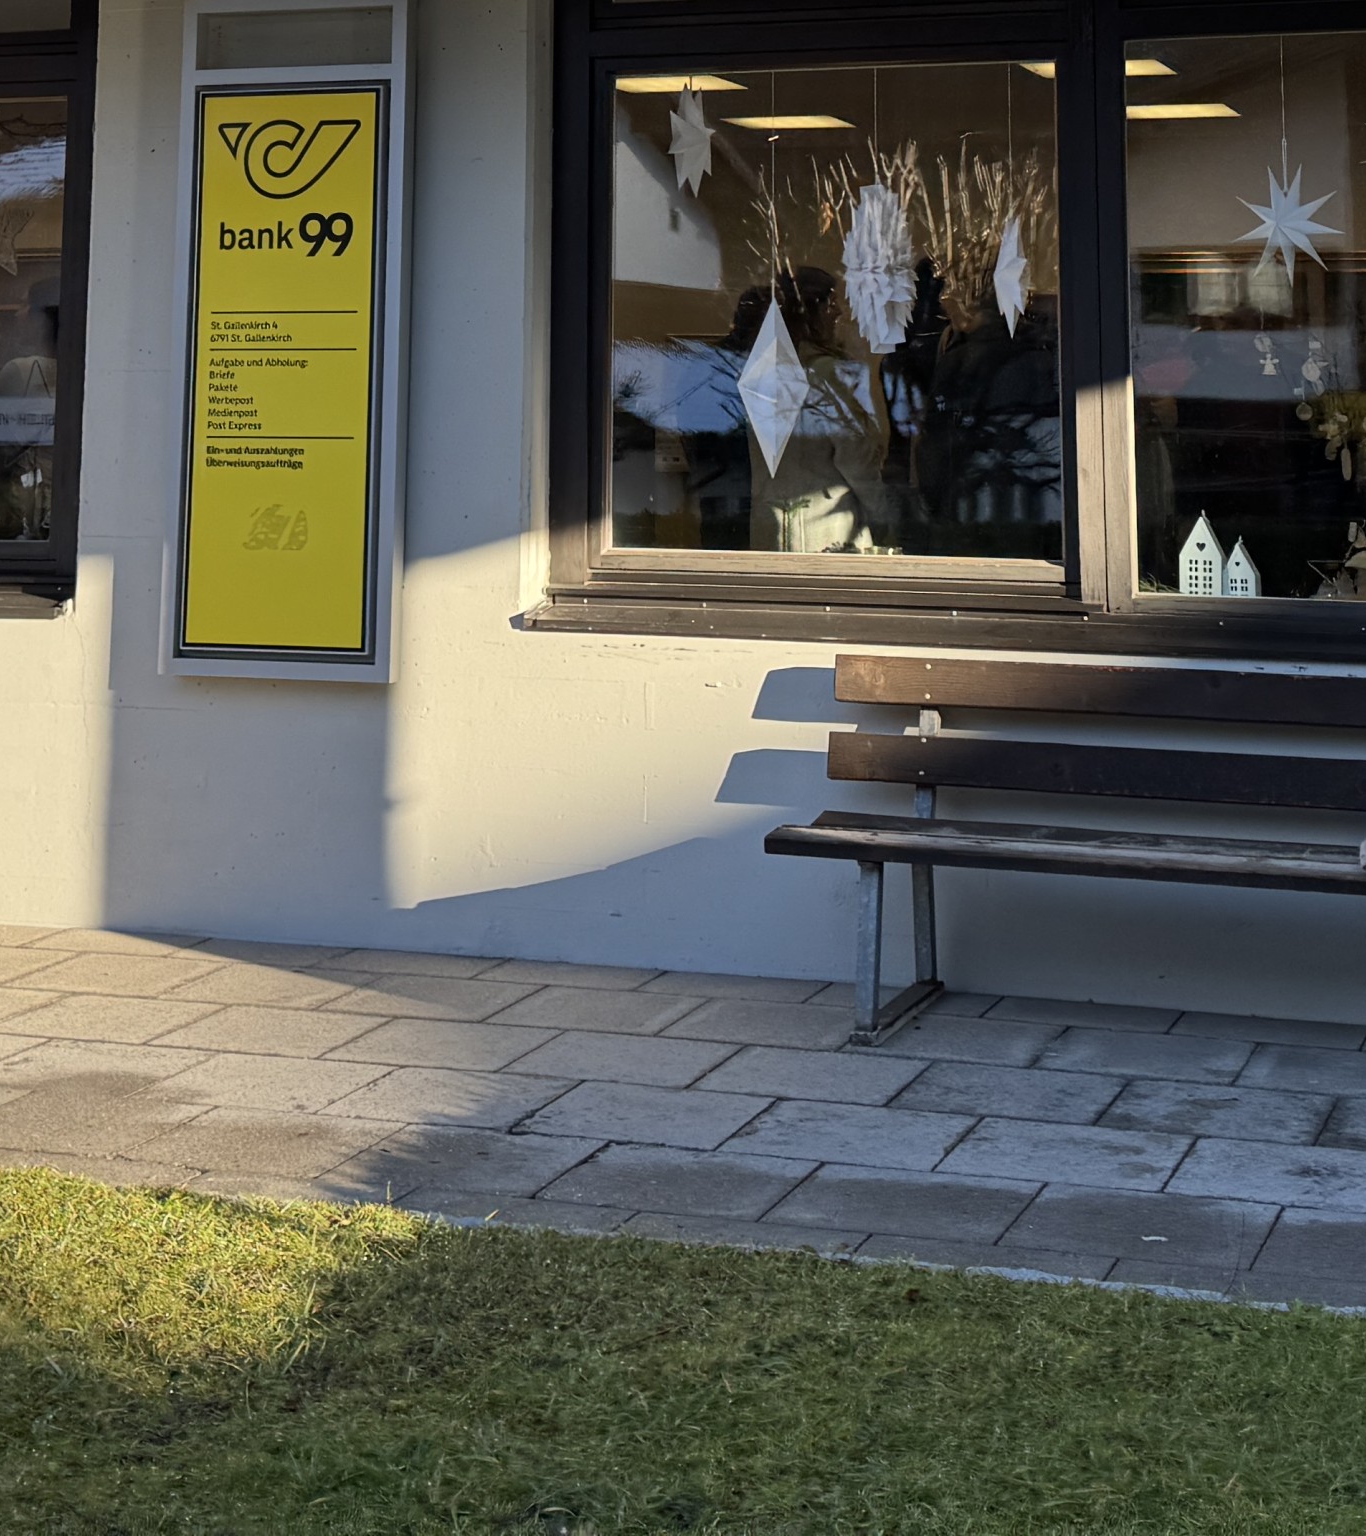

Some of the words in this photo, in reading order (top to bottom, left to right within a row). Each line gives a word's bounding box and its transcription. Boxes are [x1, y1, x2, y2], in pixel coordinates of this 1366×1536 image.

[210, 333, 229, 343] 6791
[231, 333, 242, 343] St.
[246, 358, 263, 367] und
[209, 370, 235, 380] Briefe
[208, 383, 239, 392] Pakete
[208, 396, 254, 406] Werbepost
[207, 421, 226, 430] Post
[228, 421, 262, 431] Express
